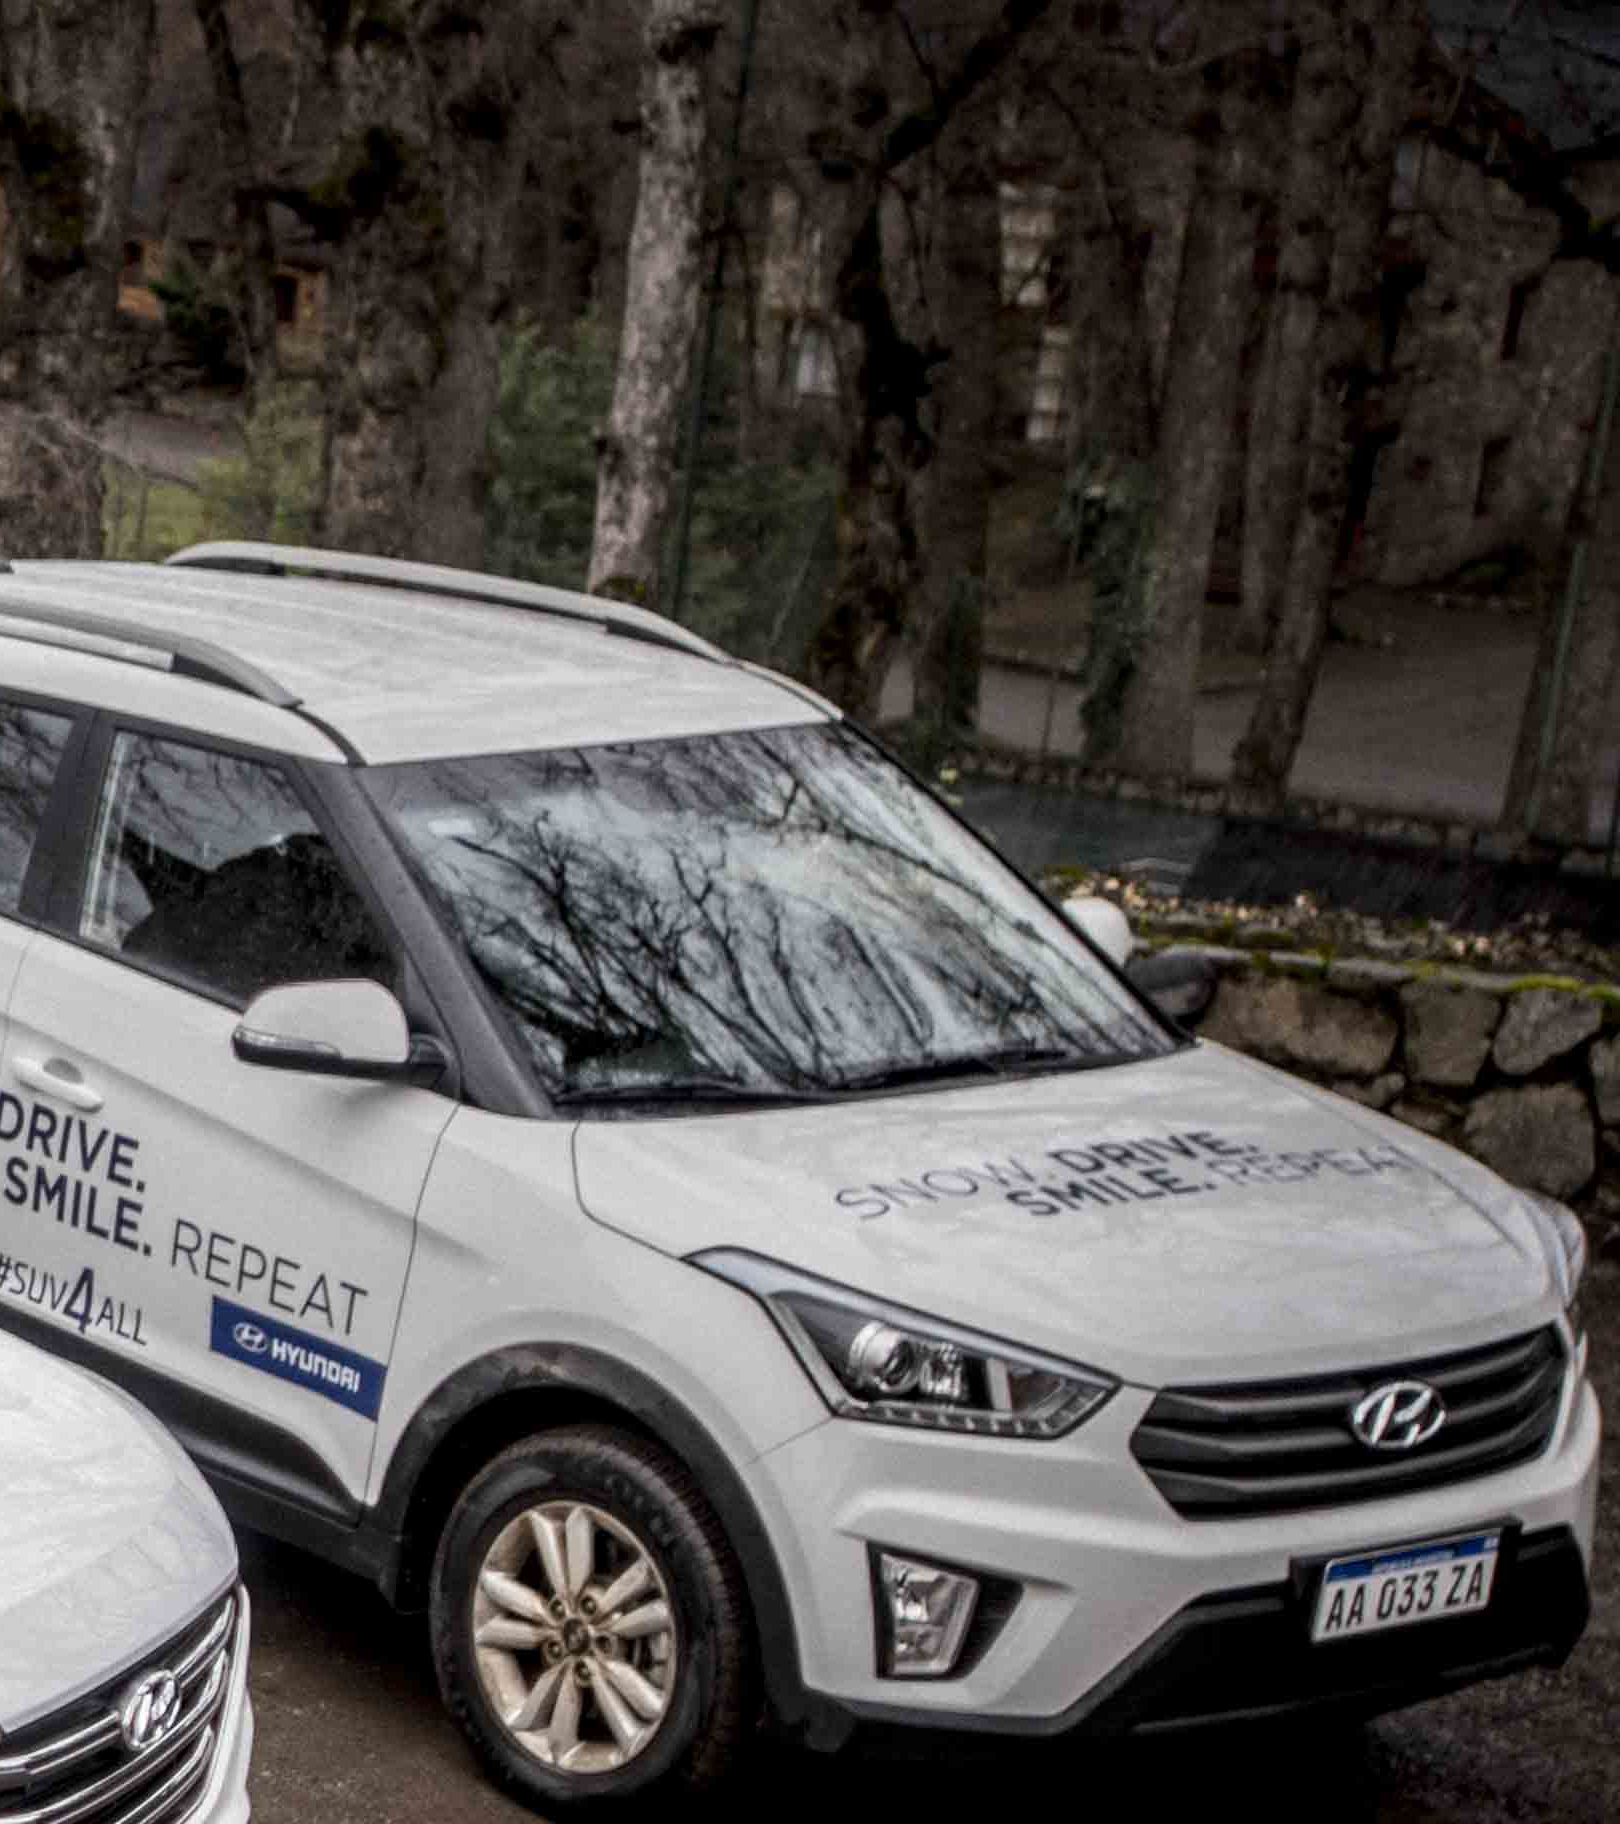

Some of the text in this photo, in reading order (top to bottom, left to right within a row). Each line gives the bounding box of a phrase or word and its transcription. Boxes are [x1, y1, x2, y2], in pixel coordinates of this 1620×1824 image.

[1047, 1131, 1258, 1173] DRIVE.
[1004, 1167, 1216, 1215] SMILE.
[4, 1159, 368, 1335] SMILE. REPEAT
[272, 1339, 360, 1392] HYUNDAI
[1324, 1581, 1366, 1632] AA
[1376, 1569, 1439, 1621] 033
[1445, 1561, 1485, 1608] ZA
